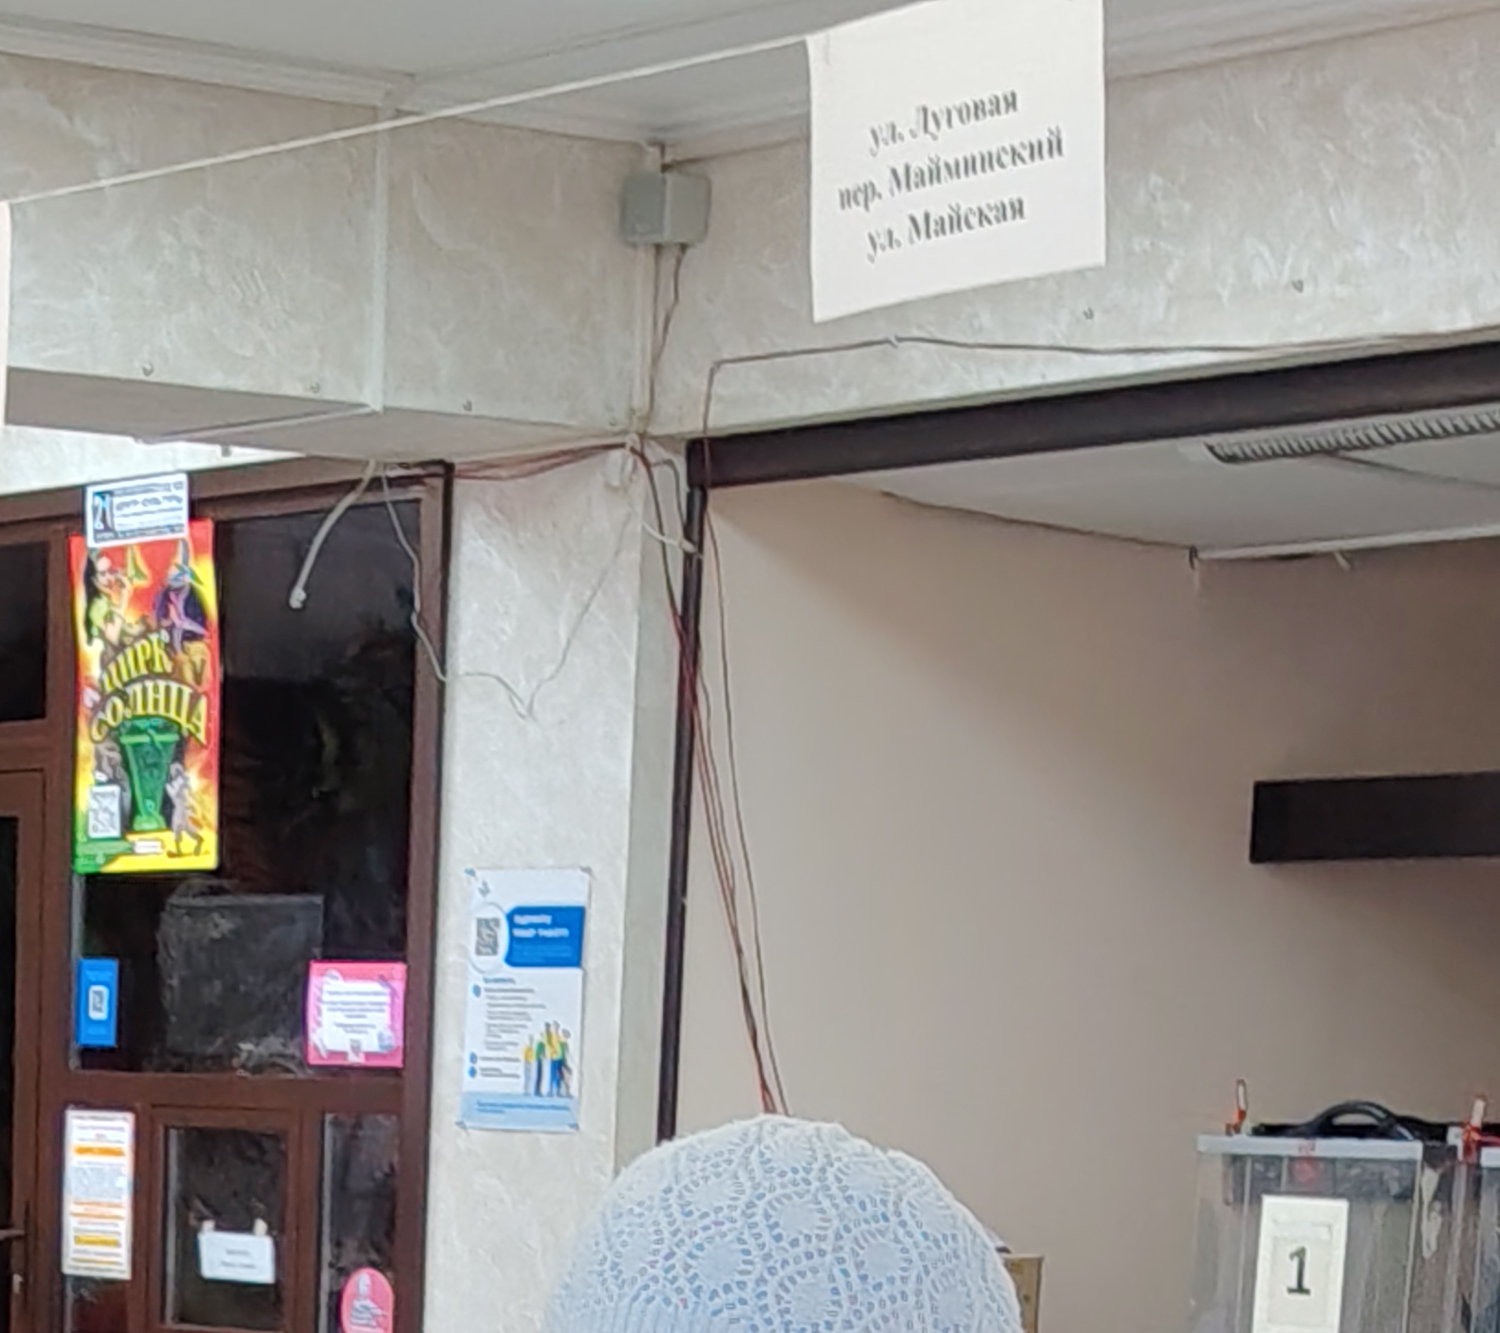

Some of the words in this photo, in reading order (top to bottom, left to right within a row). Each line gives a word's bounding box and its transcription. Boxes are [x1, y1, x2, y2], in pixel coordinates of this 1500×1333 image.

[869, 121, 904, 157] ул.
[909, 89, 1019, 141] Луговая
[838, 180, 882, 212] пер.
[889, 126, 1064, 197] Майминский
[866, 228, 901, 263] ул.
[908, 197, 1026, 245] Майская
[102, 636, 174, 694] ЦИРК
[90, 679, 209, 748] СОЛНЦА
[1286, 1246, 1311, 1296] 1
